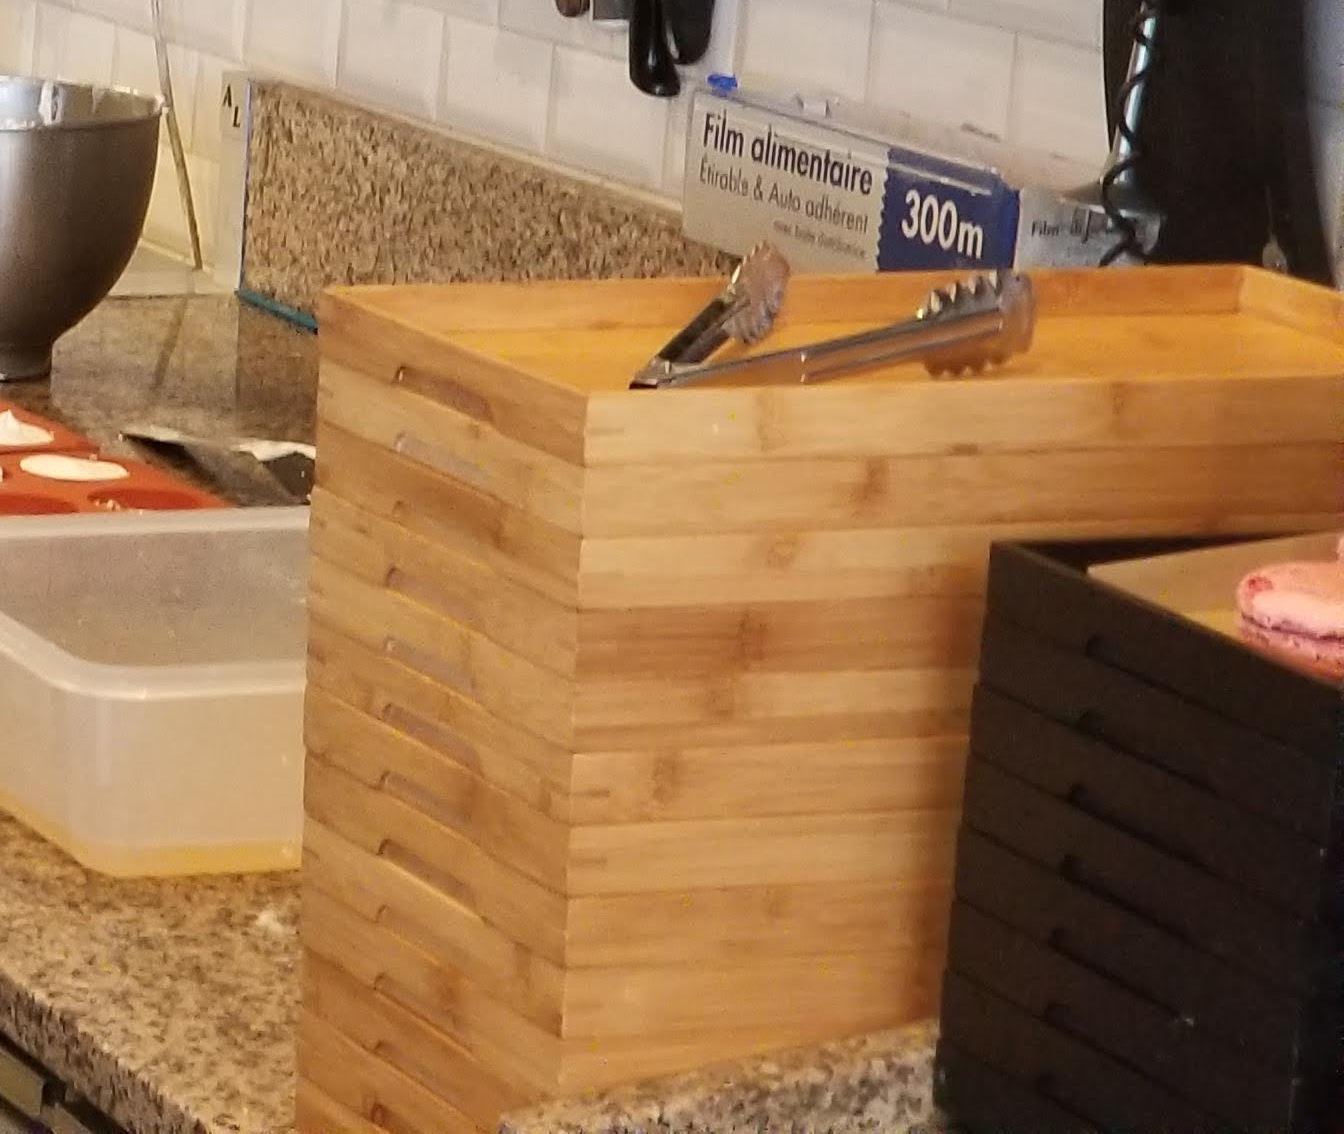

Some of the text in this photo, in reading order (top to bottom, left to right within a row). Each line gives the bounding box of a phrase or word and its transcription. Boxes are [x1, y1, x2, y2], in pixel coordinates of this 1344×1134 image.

[703, 110, 873, 195] Film alimentaire
[753, 173, 764, 202] &
[768, 182, 801, 212] Auto
[805, 193, 868, 235] adhérent
[901, 189, 984, 259] 300m
